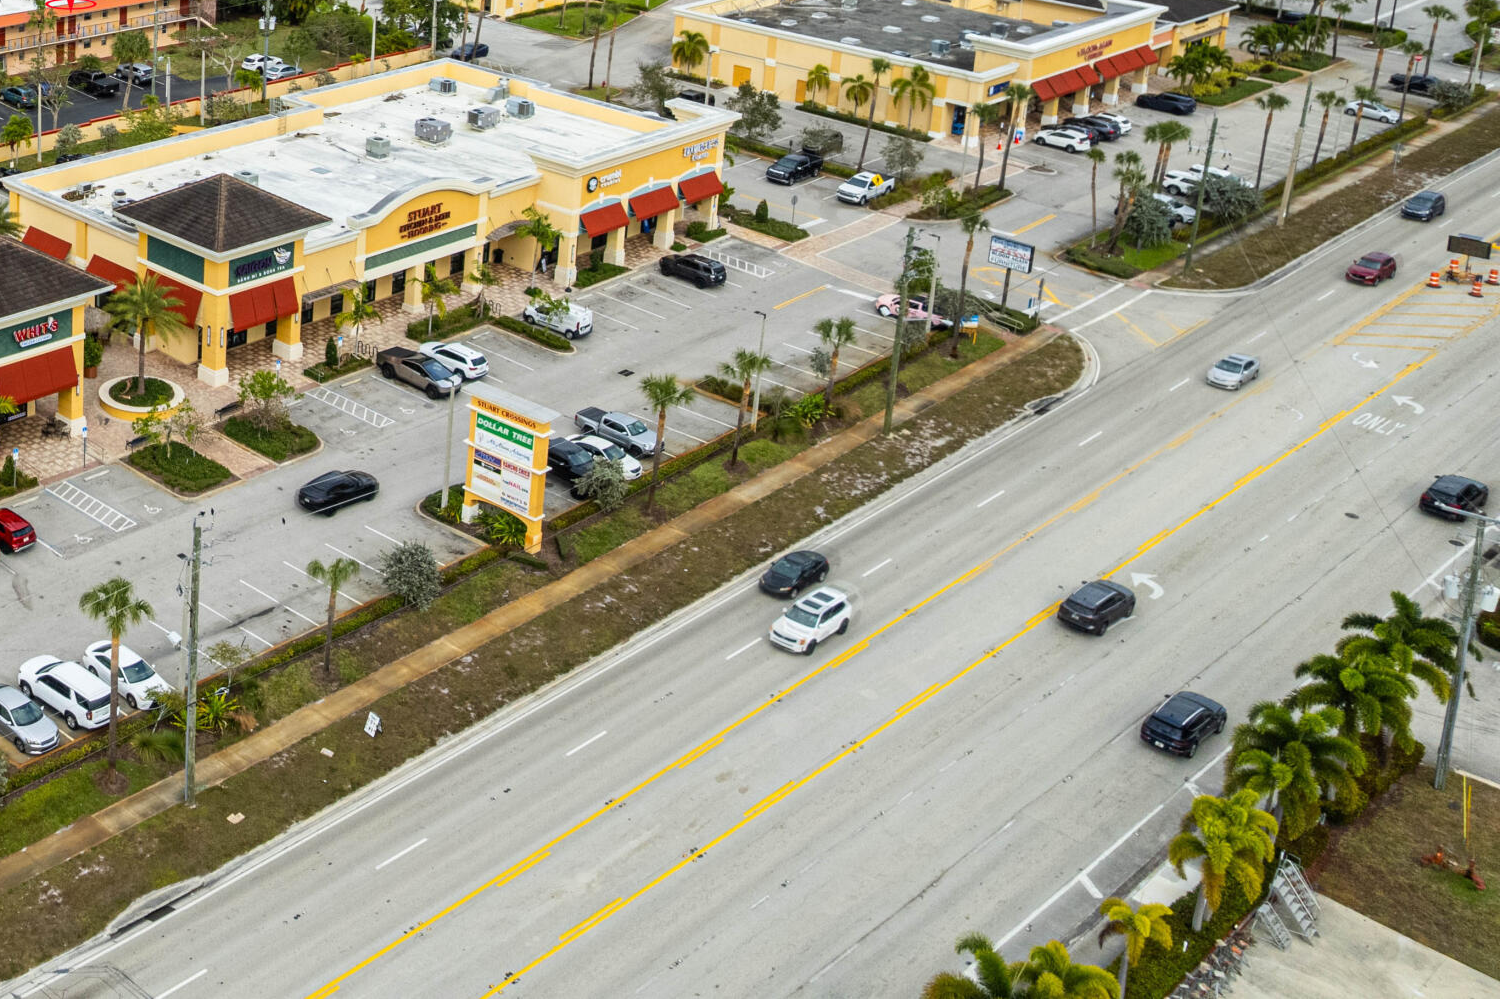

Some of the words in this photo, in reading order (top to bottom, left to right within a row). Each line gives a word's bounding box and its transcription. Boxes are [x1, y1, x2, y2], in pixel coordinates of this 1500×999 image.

[407, 202, 443, 222] STUART
[477, 400, 500, 413] STUART
[501, 410, 536, 429] CROSSINGS
[1352, 412, 1406, 436] ONLY
[477, 417, 510, 436] DOLLAR
[512, 430, 533, 446] TREE
